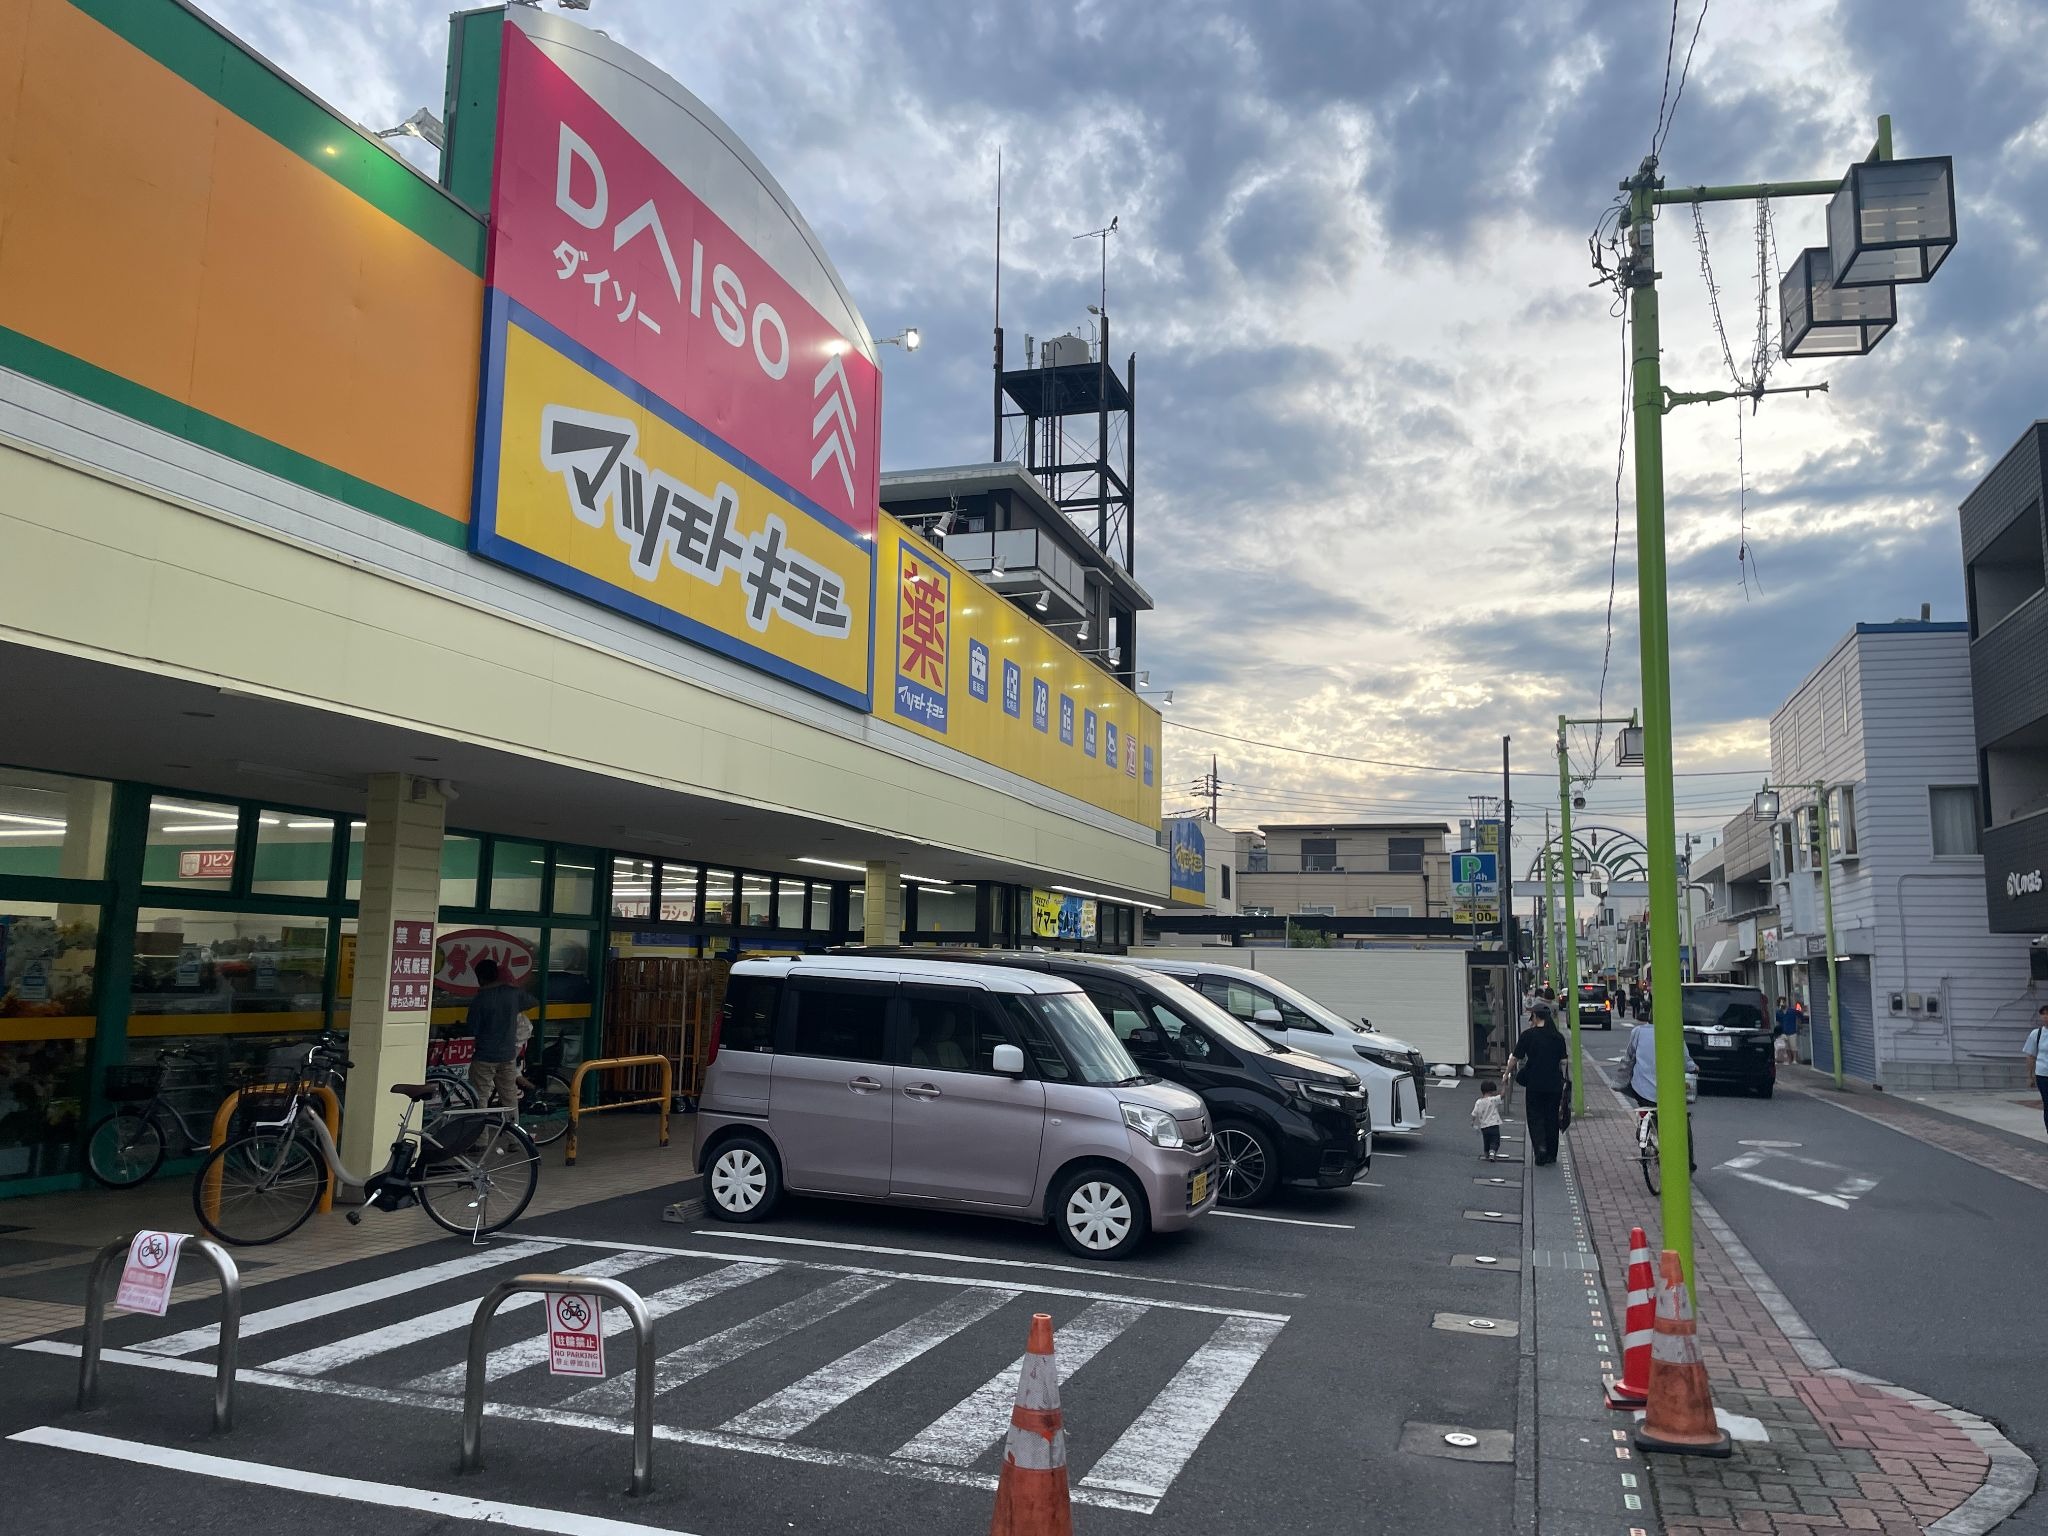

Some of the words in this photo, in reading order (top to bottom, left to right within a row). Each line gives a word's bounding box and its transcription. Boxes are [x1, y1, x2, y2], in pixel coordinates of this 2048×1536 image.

[556, 121, 790, 381] DAISO
[553, 240, 661, 335] ダイソー
[550, 419, 847, 629] マツモトキヨシ
[902, 560, 945, 688] 薬
[898, 685, 945, 719] マツモトキヨシ
[393, 956, 430, 975] 火気厳禁
[390, 997, 427, 1008] 持ち込み禁止
[555, 1335, 596, 1349] 駐輪禁止
[566, 1350, 598, 1360] PARKING
